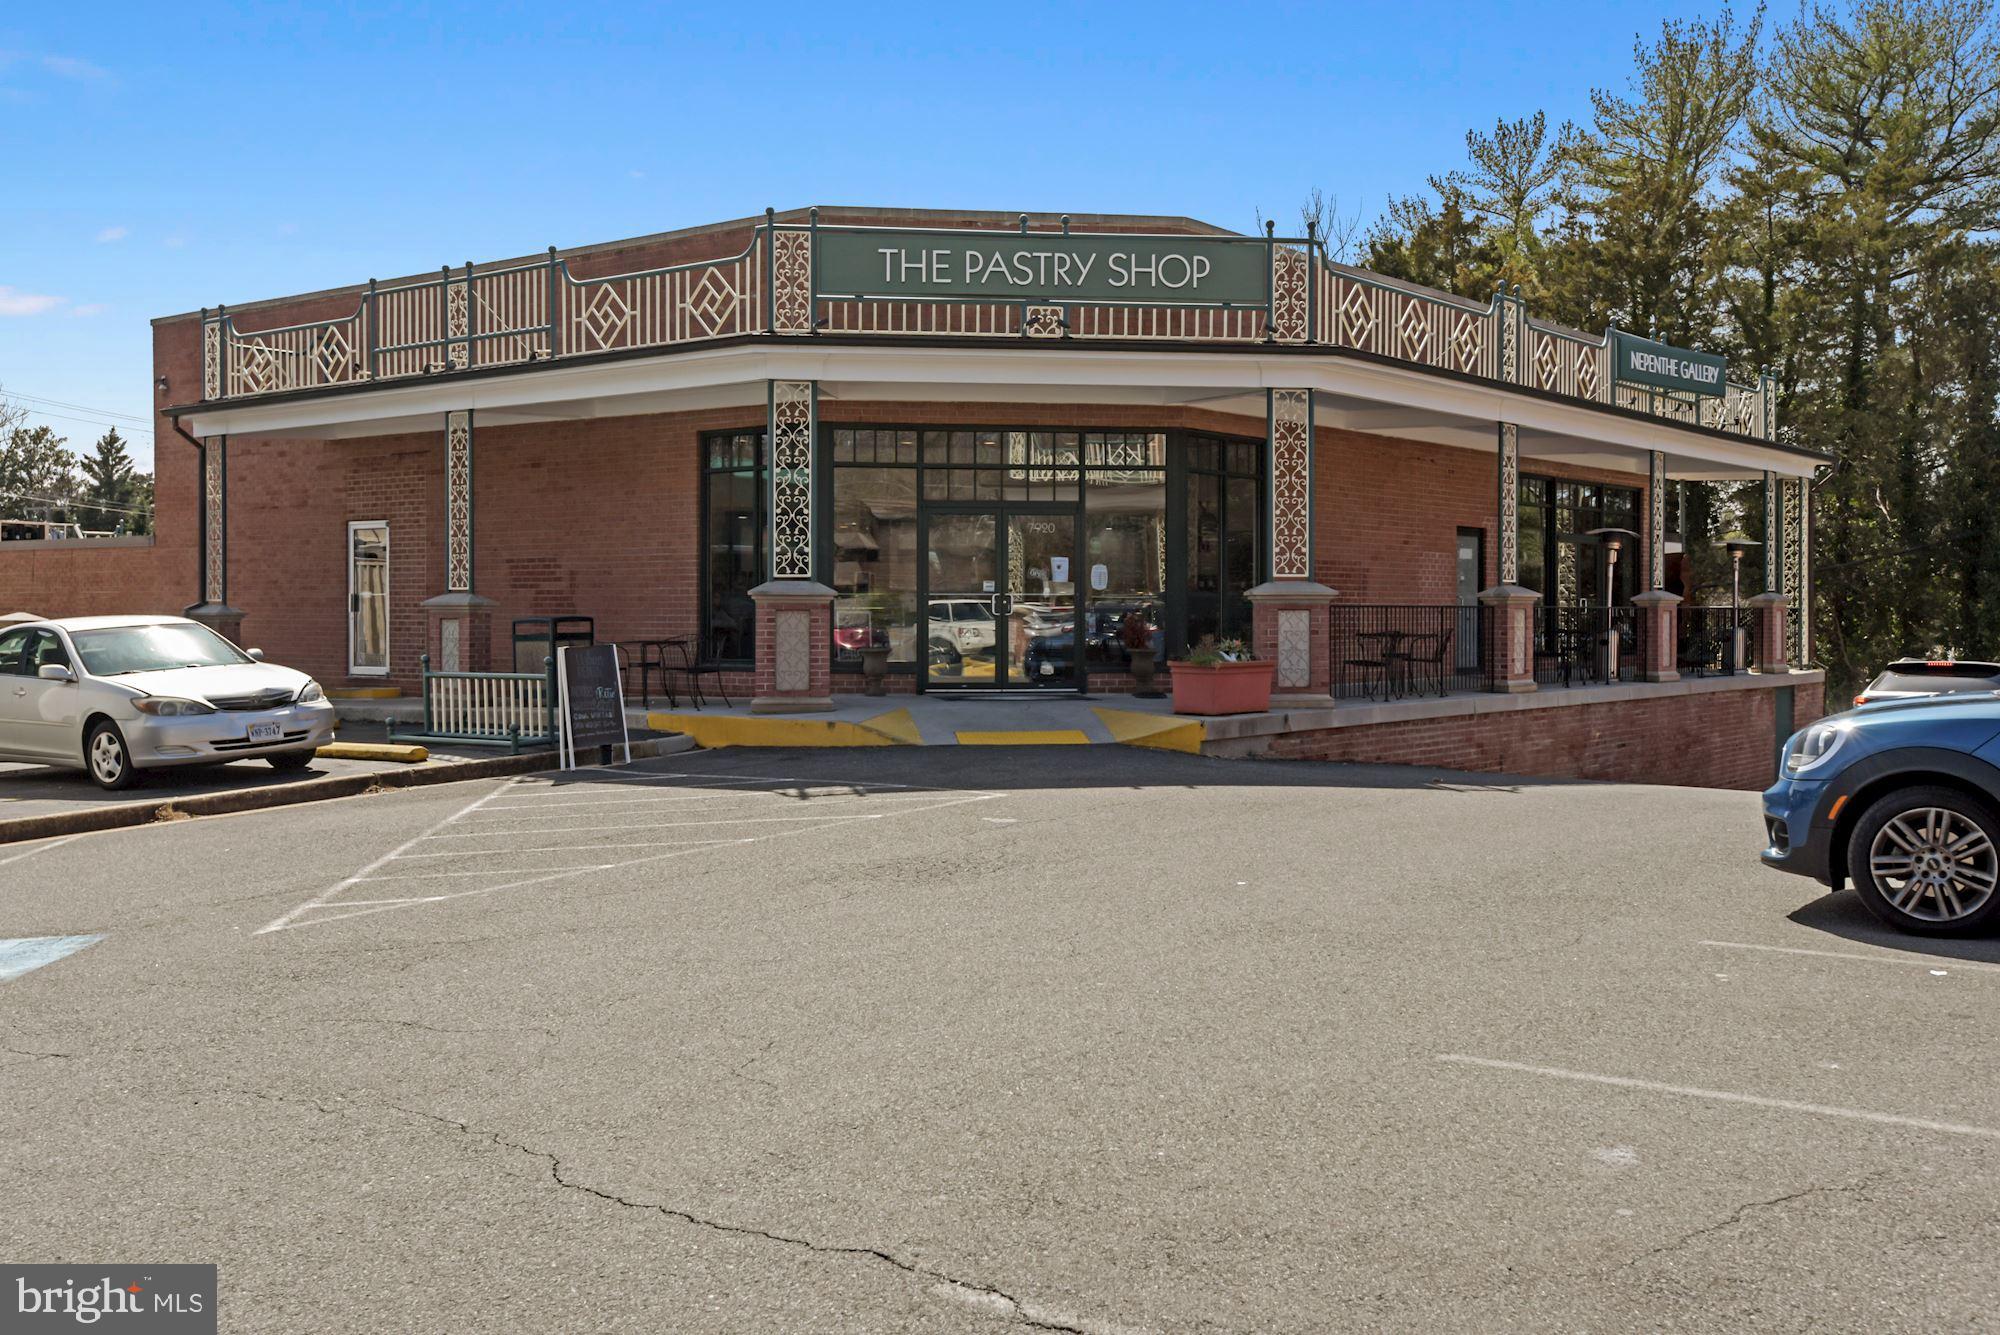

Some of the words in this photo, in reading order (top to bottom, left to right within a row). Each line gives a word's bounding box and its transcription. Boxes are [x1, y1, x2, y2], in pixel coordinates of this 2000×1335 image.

[879, 248, 951, 283] THE
[964, 250, 1096, 286] PASTRY
[1107, 253, 1211, 288] SHOP
[1630, 351, 1678, 377] NEPENTHE
[1680, 360, 1719, 384] GALLERY
